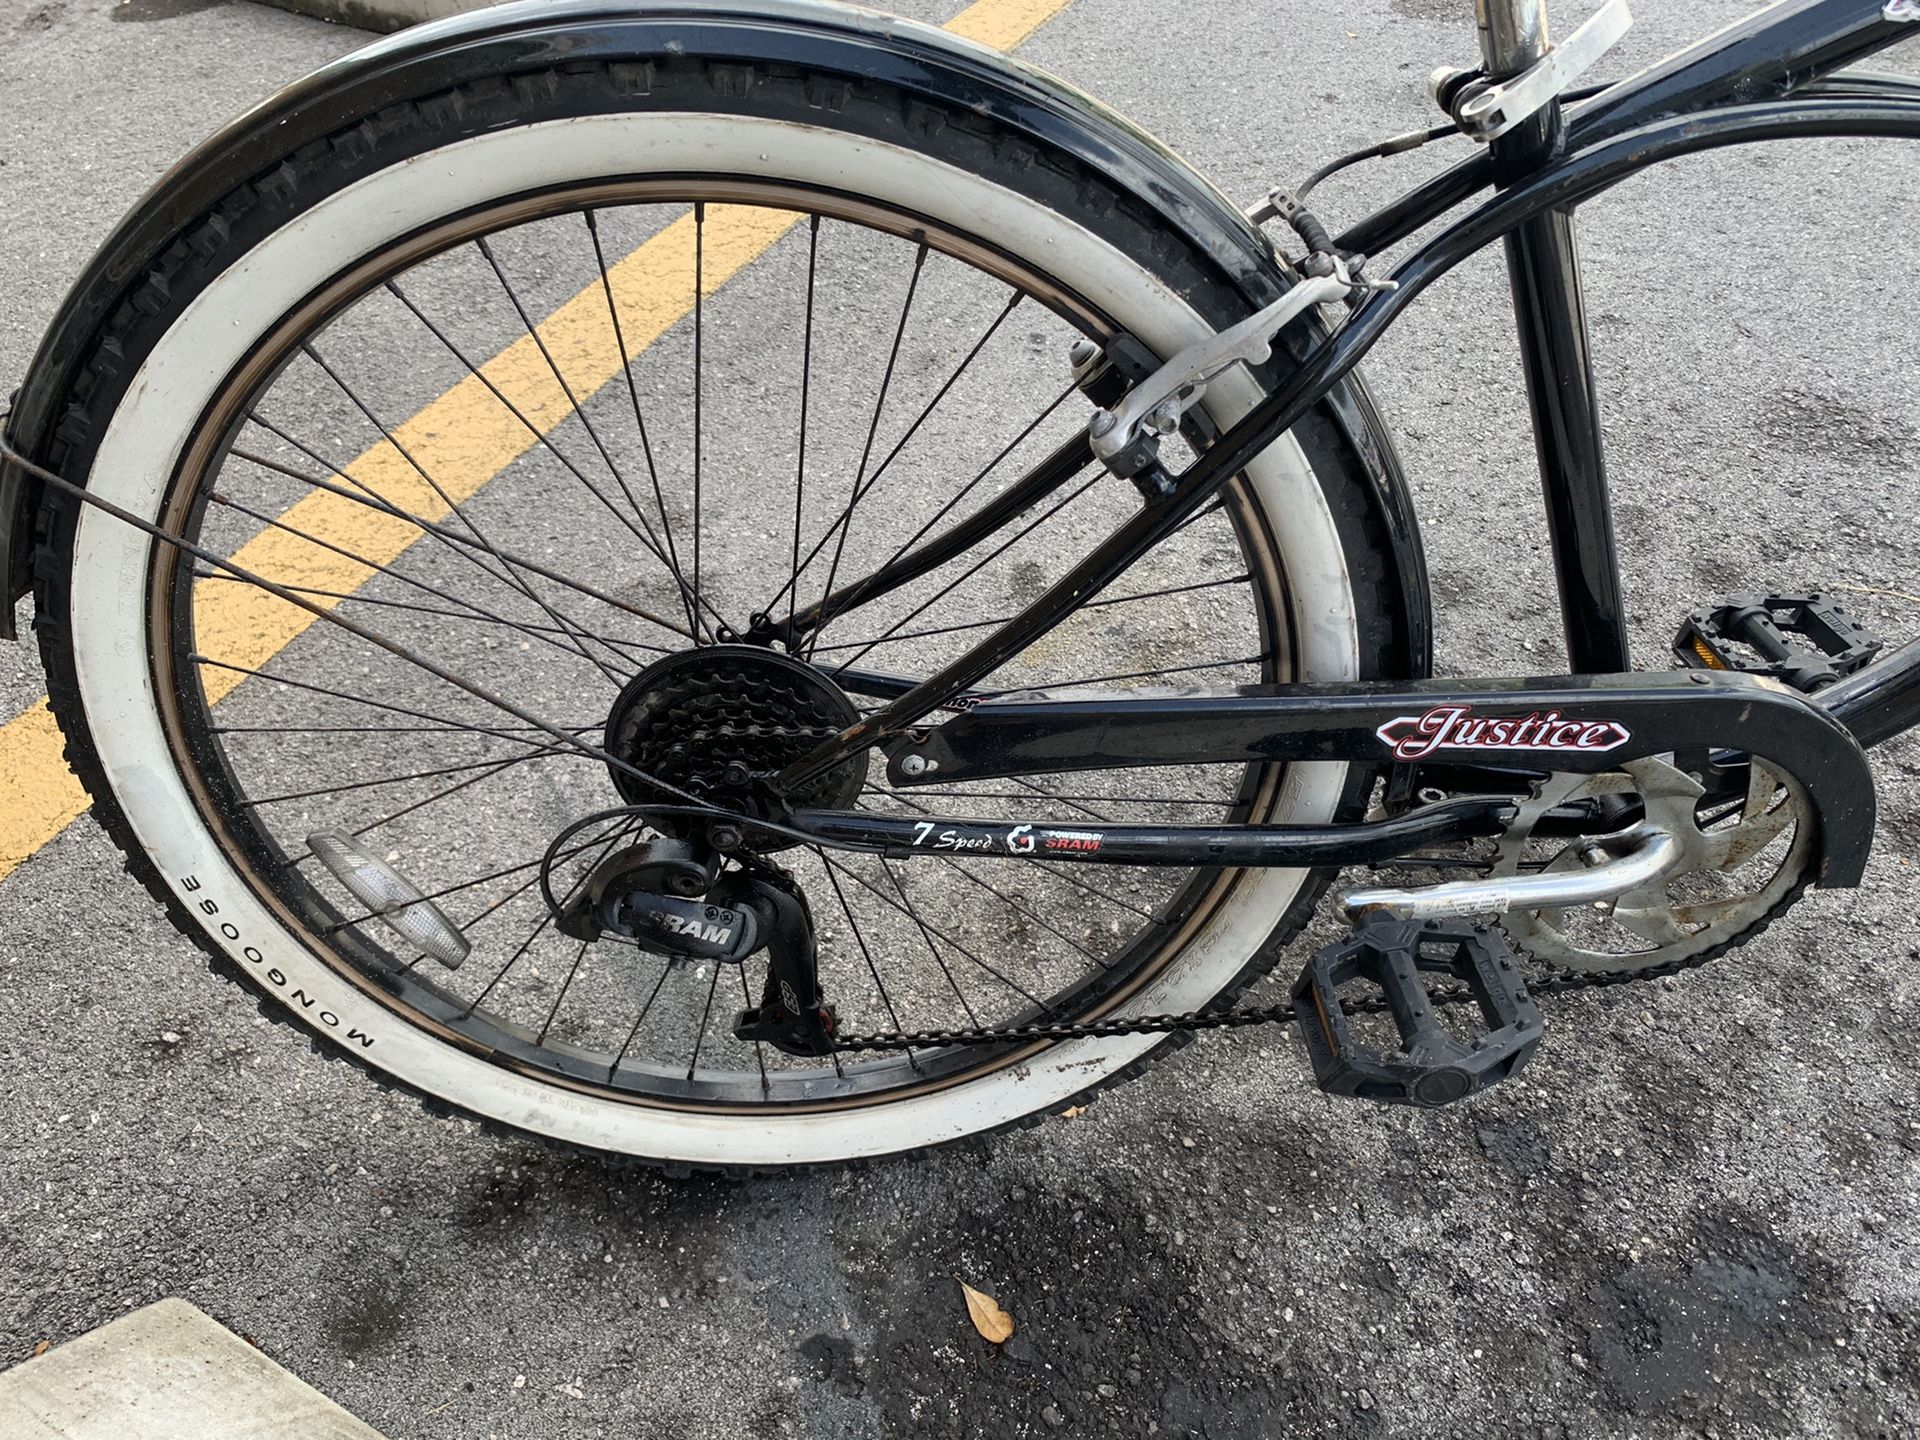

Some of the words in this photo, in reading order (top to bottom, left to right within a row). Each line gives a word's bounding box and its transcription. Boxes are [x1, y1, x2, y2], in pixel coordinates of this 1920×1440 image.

[1392, 704, 1611, 759] Justice
[912, 821, 936, 846] 7
[933, 830, 994, 849] Speed
[1045, 838, 1101, 850] SRAM
[181, 874, 375, 1048] MONGOOSE
